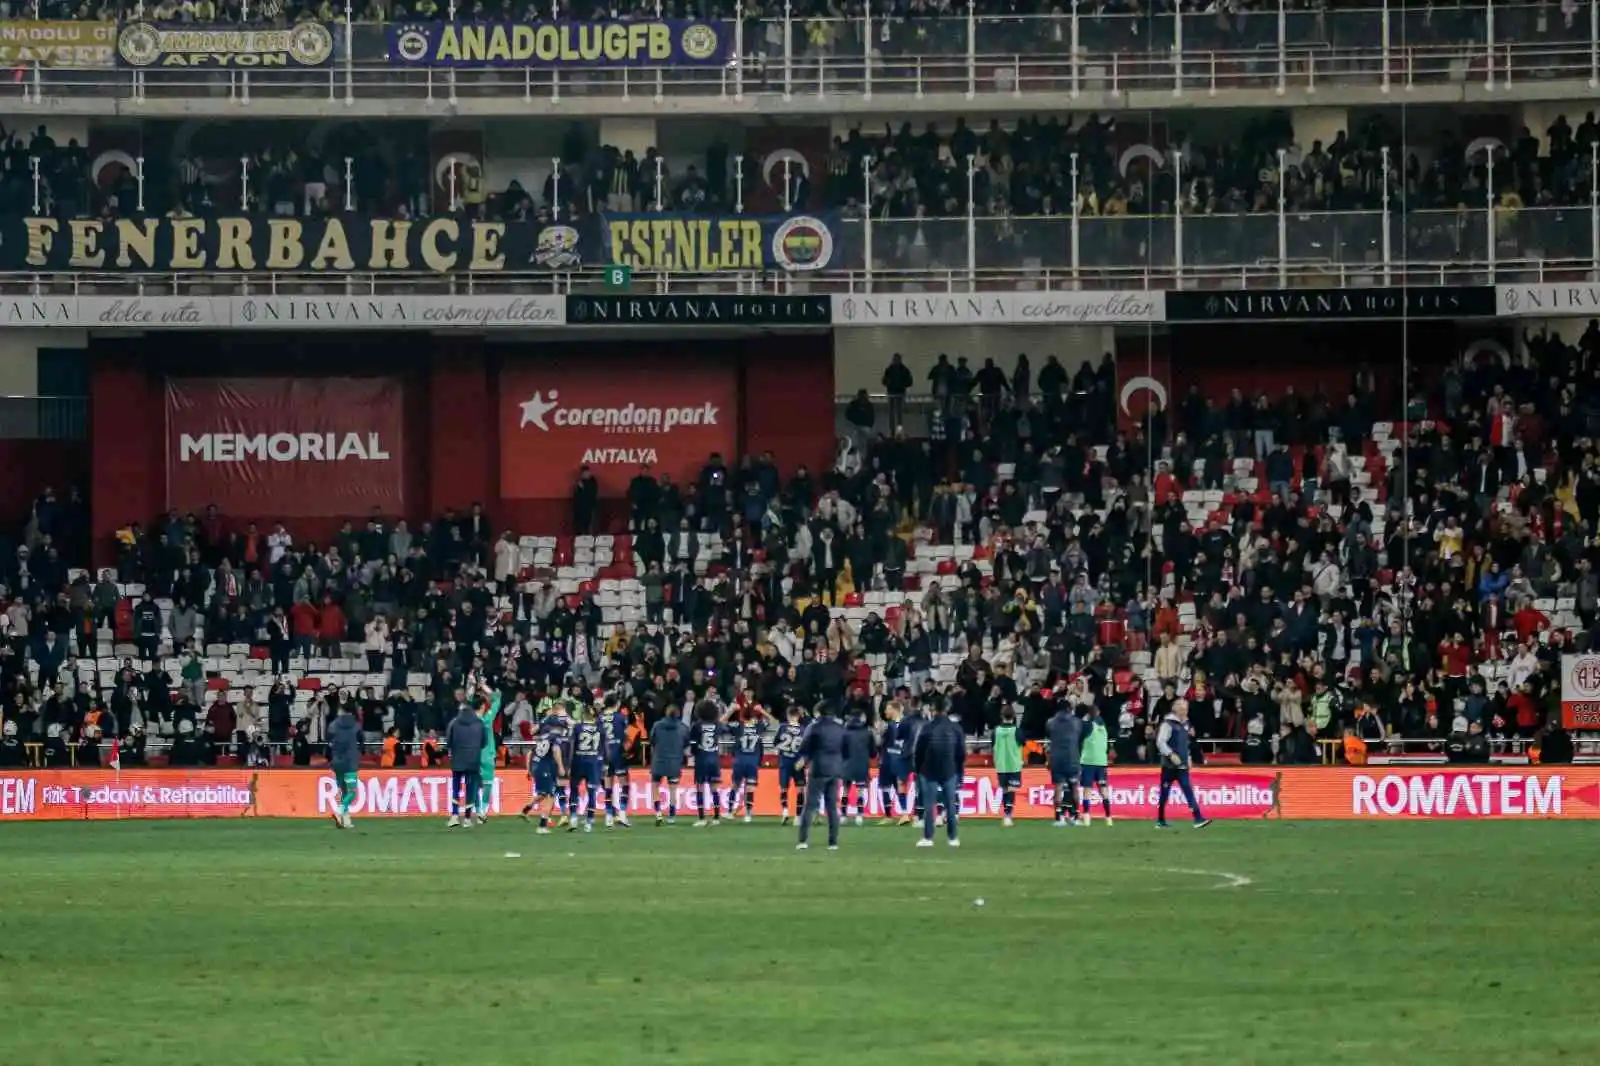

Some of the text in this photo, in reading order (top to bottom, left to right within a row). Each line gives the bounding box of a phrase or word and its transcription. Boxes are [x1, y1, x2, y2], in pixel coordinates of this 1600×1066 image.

[0, 27, 80, 41] NADOLU
[436, 24, 672, 61] ANADOLUGFB
[162, 53, 287, 66] AFYON
[23, 216, 507, 273] FENERBAHÇE
[609, 218, 764, 271] ESENLER
[612, 269, 624, 285] B
[0, 302, 70, 320] ANA
[99, 299, 204, 323] dolce vita
[264, 301, 408, 321] NIRVANA
[422, 298, 559, 326] cosmopolitan
[594, 301, 721, 321] NIRVANA
[864, 298, 1006, 318] NIRVANA
[1022, 292, 1156, 321] cosmopolitan
[1224, 295, 1352, 313] NIRVANA
[553, 402, 719, 433] corendon park
[180, 432, 390, 462] MEMORIAL
[581, 449, 659, 465] ANTALYA
[1352, 774, 1562, 814] ROMATEM
